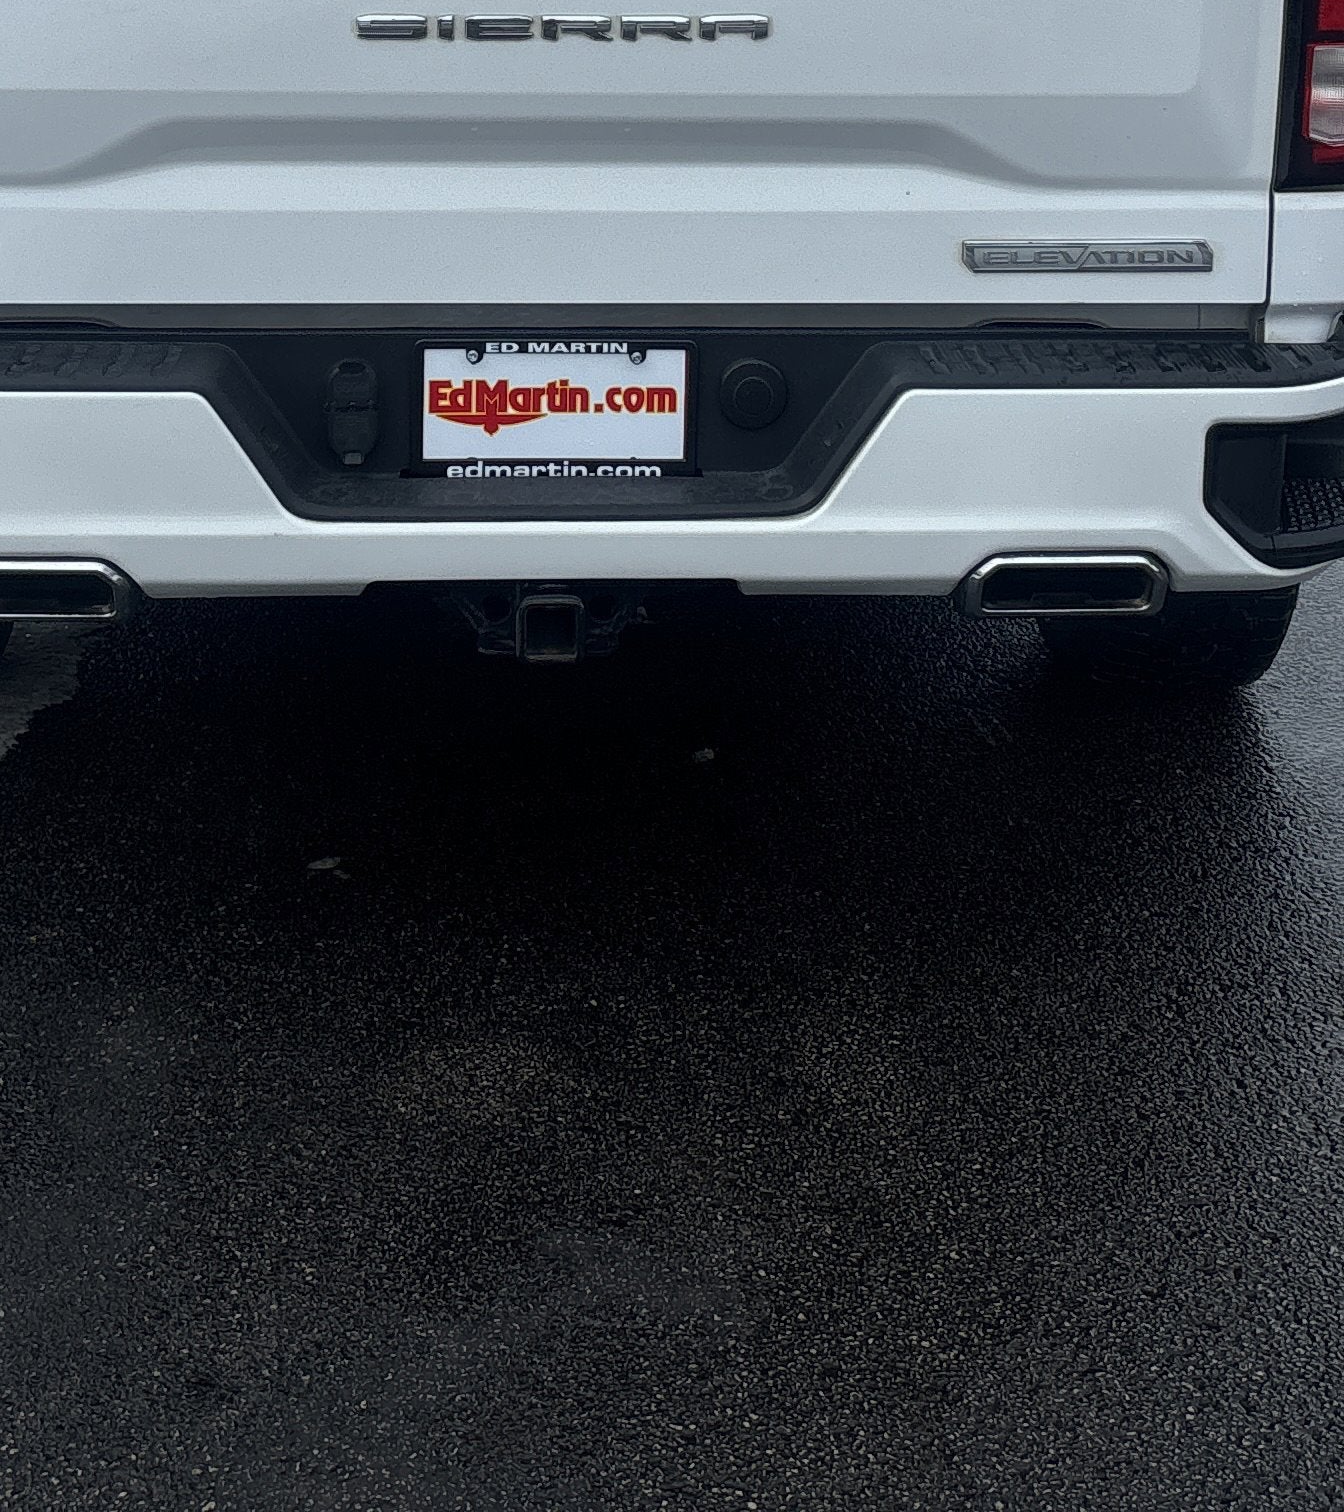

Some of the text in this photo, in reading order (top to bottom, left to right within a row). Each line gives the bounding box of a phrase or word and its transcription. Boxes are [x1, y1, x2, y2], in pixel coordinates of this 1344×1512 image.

[355, 13, 770, 42] SIERRA
[983, 249, 1195, 265] ELEVATION
[485, 342, 628, 354] ED MARTIN
[428, 378, 678, 414] EdMartin.com
[446, 461, 662, 478] edmartin.com
